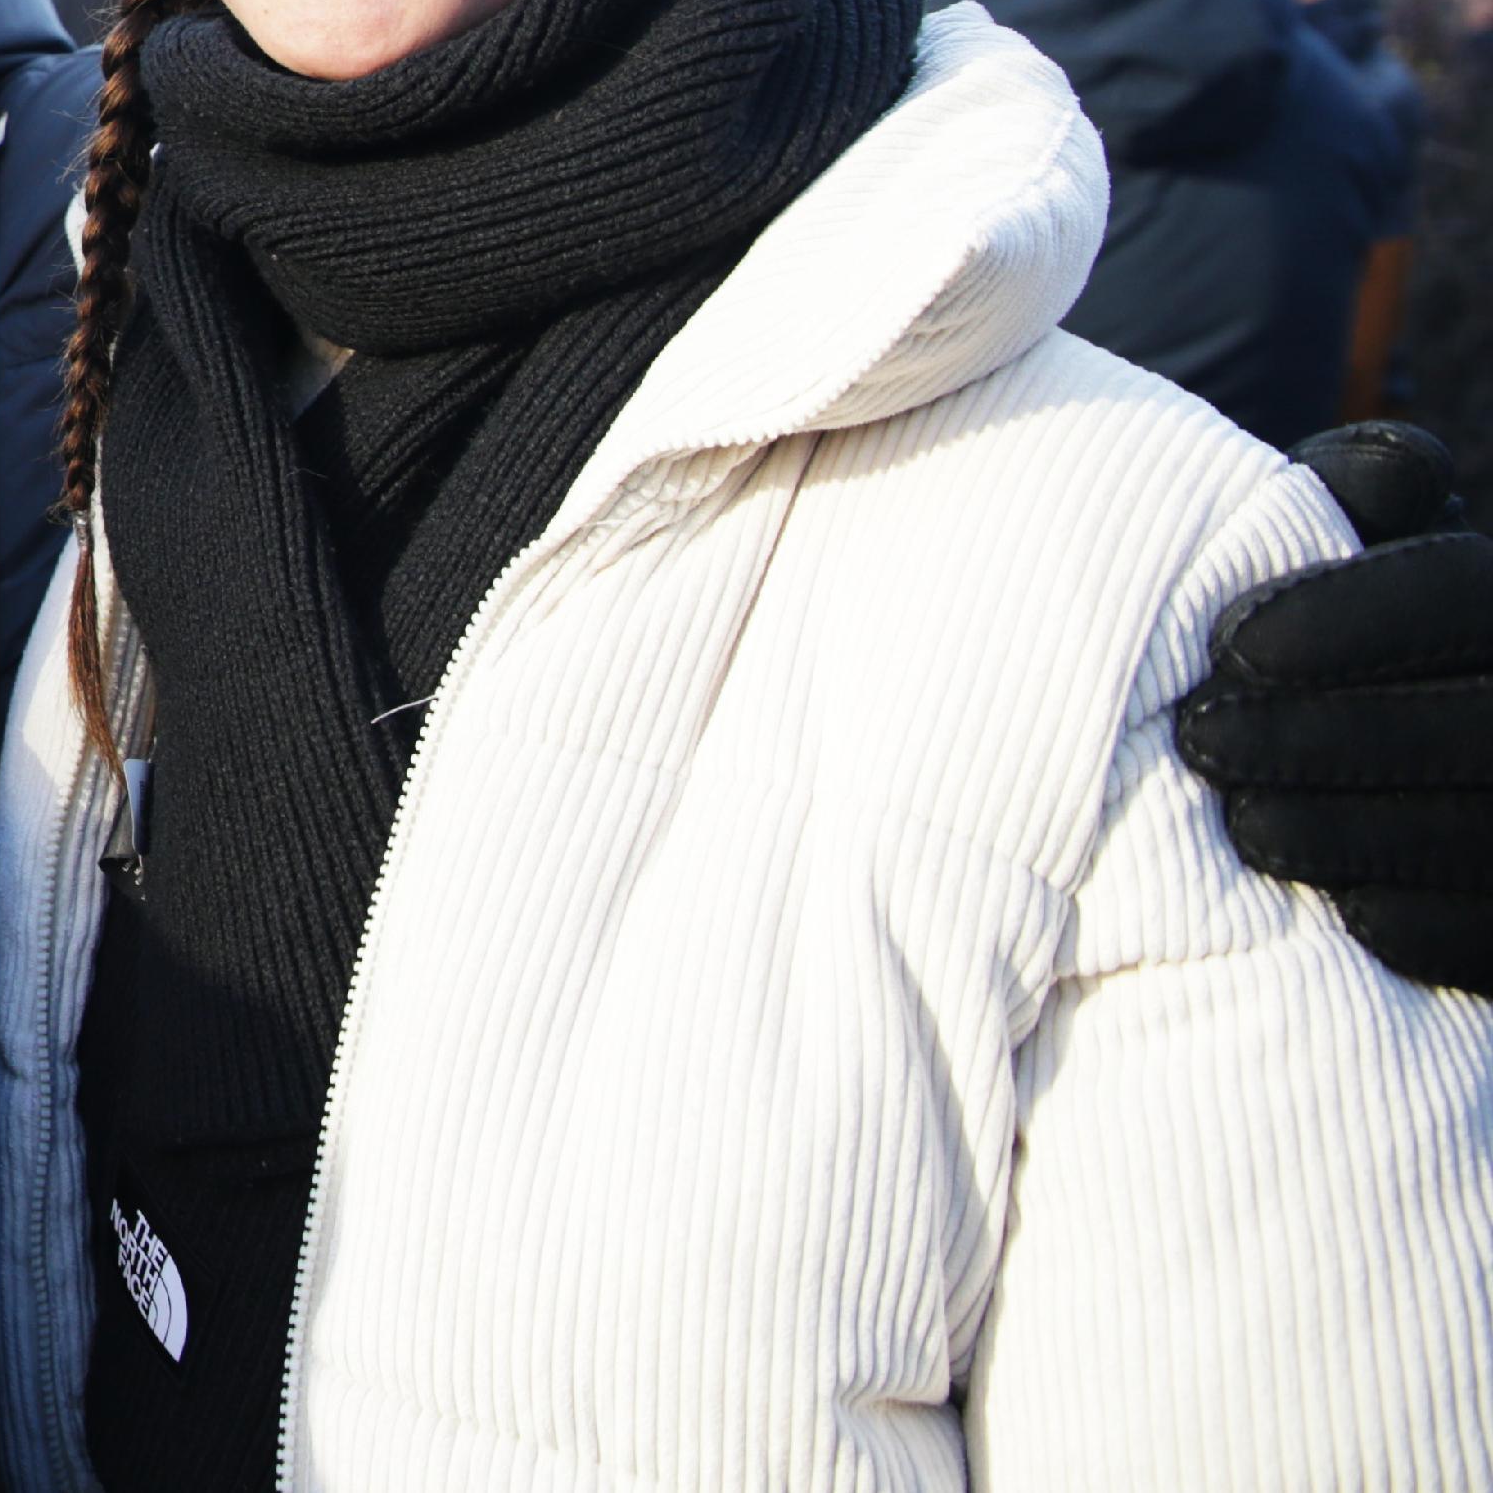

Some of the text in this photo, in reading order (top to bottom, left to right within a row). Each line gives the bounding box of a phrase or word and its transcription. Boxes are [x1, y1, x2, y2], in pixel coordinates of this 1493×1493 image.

[110, 1198, 159, 1297] NORTH
[133, 1209, 169, 1272] THE
[118, 1243, 151, 1320] FACE
